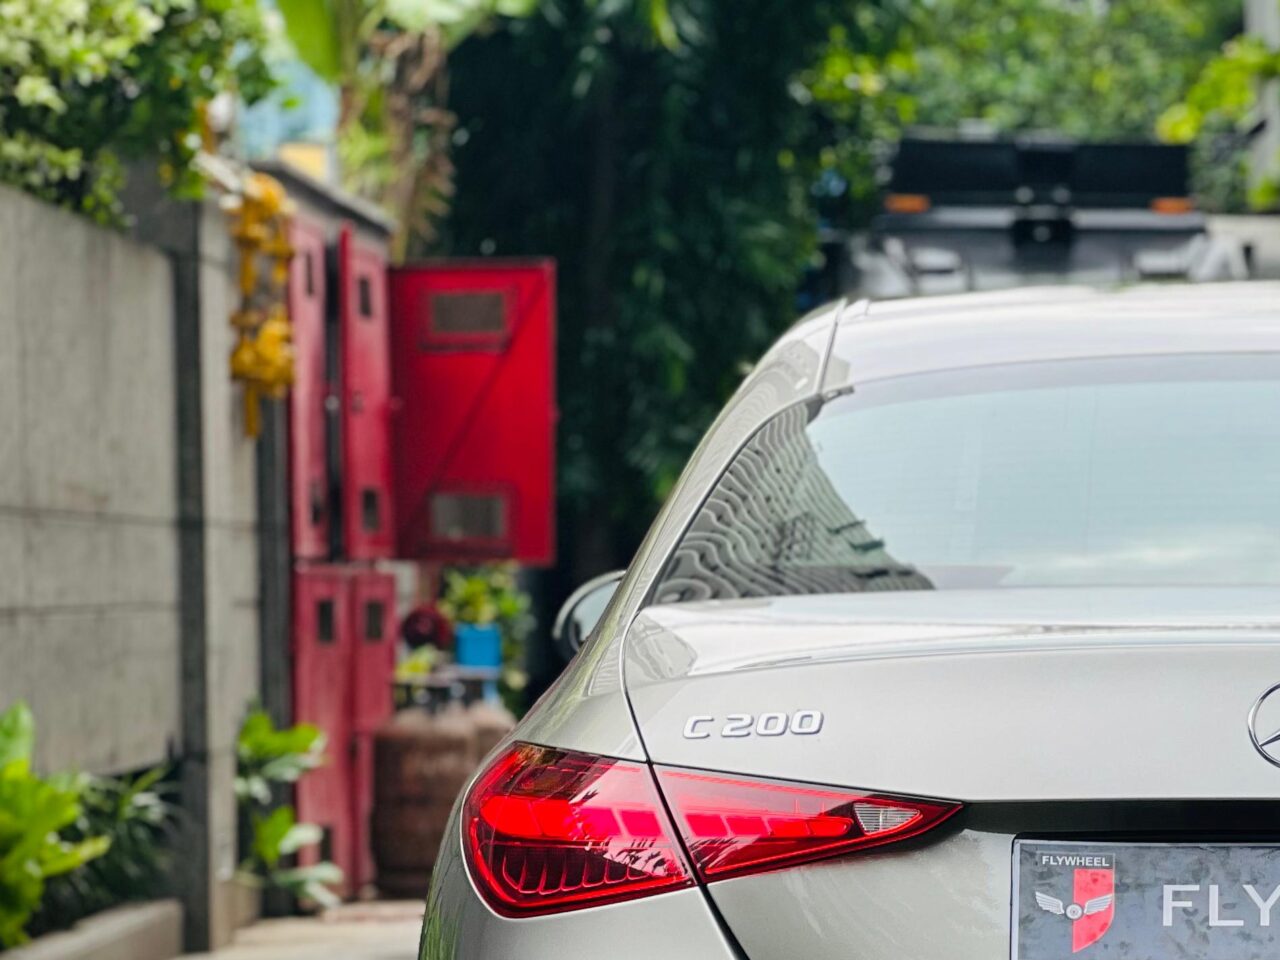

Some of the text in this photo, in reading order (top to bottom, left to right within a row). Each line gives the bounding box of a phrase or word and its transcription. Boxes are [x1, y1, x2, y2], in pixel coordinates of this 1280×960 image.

[683, 709, 824, 739] C 200
[1042, 855, 1110, 867] FLYWHEEL
